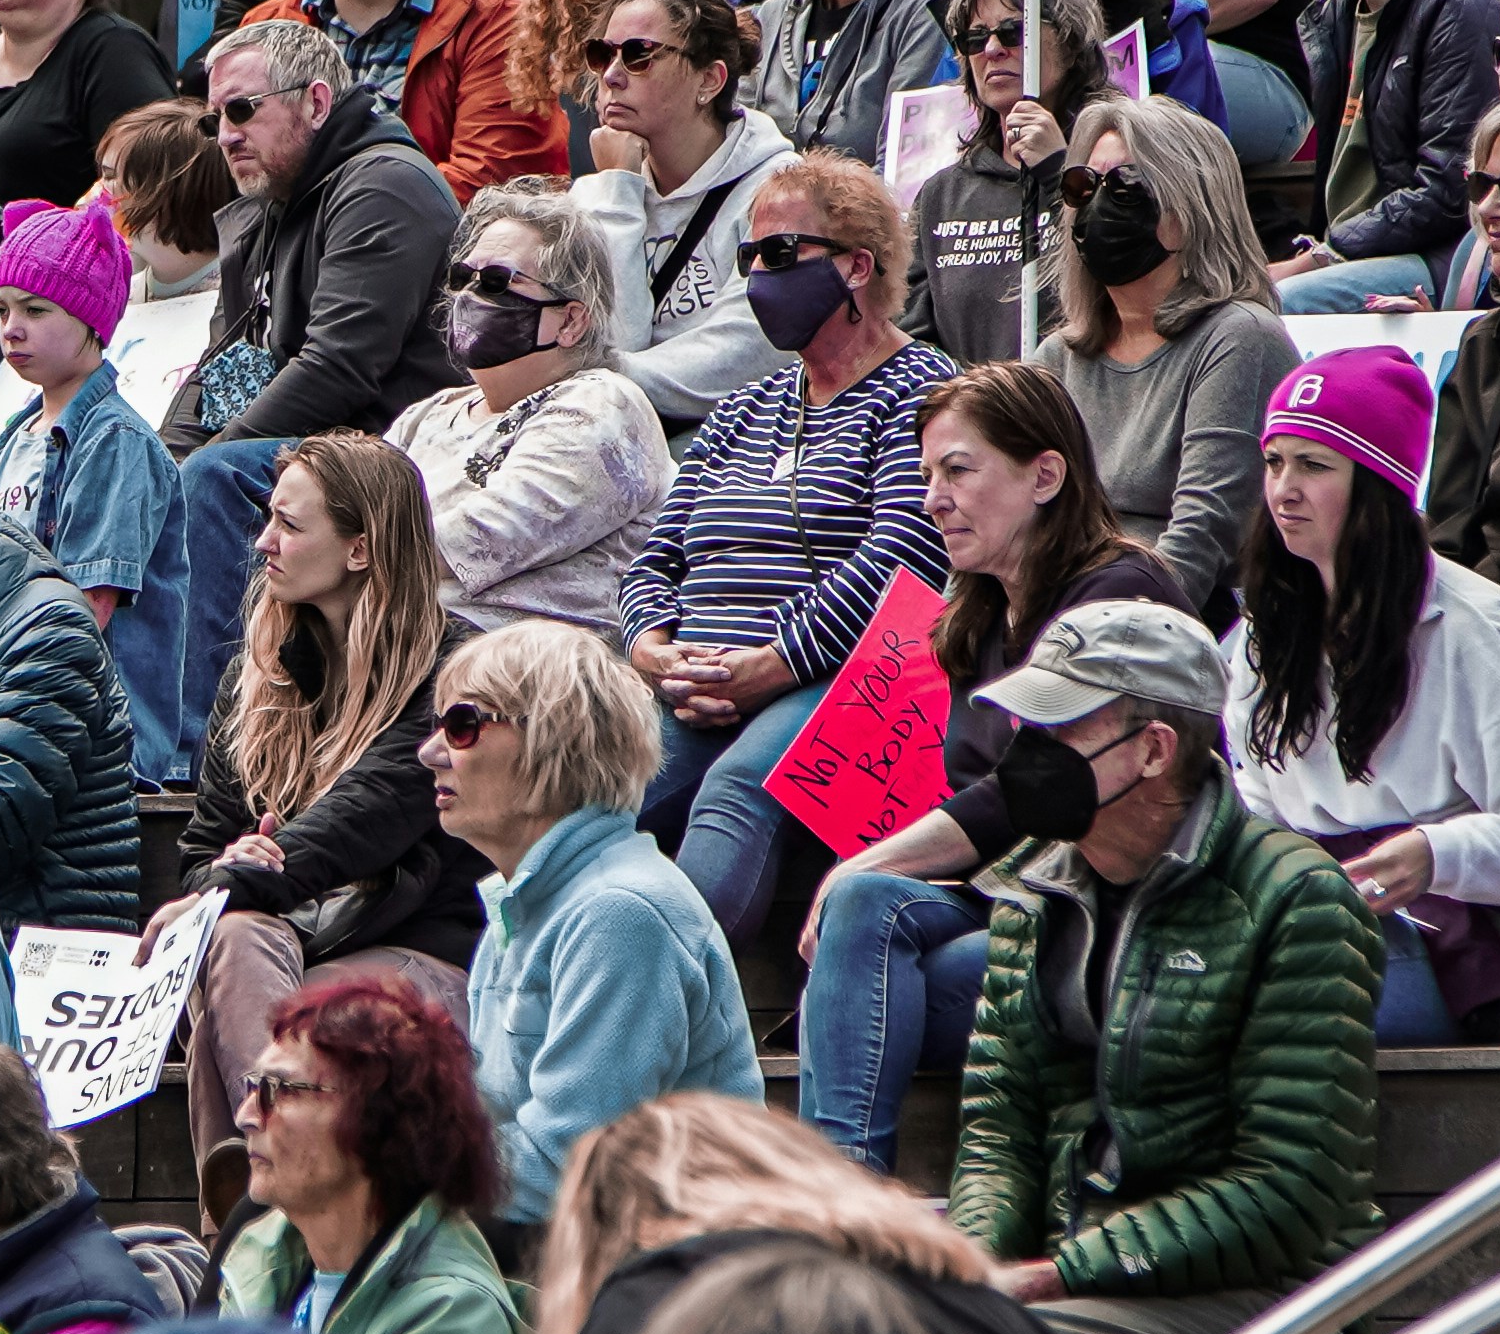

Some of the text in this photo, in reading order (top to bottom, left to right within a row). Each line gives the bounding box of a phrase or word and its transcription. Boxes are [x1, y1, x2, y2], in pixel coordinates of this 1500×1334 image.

[933, 221, 968, 238] JUST
[968, 220, 987, 236] BE
[987, 219, 999, 235] A
[936, 253, 975, 269] SPREAD
[976, 250, 1002, 266] JOY,
[954, 238, 969, 252] BE
[836, 630, 920, 723] YOUR
[855, 699, 929, 786] BODY
[44, 953, 192, 1029] BODIES
[72, 1048, 157, 1114] BANS
